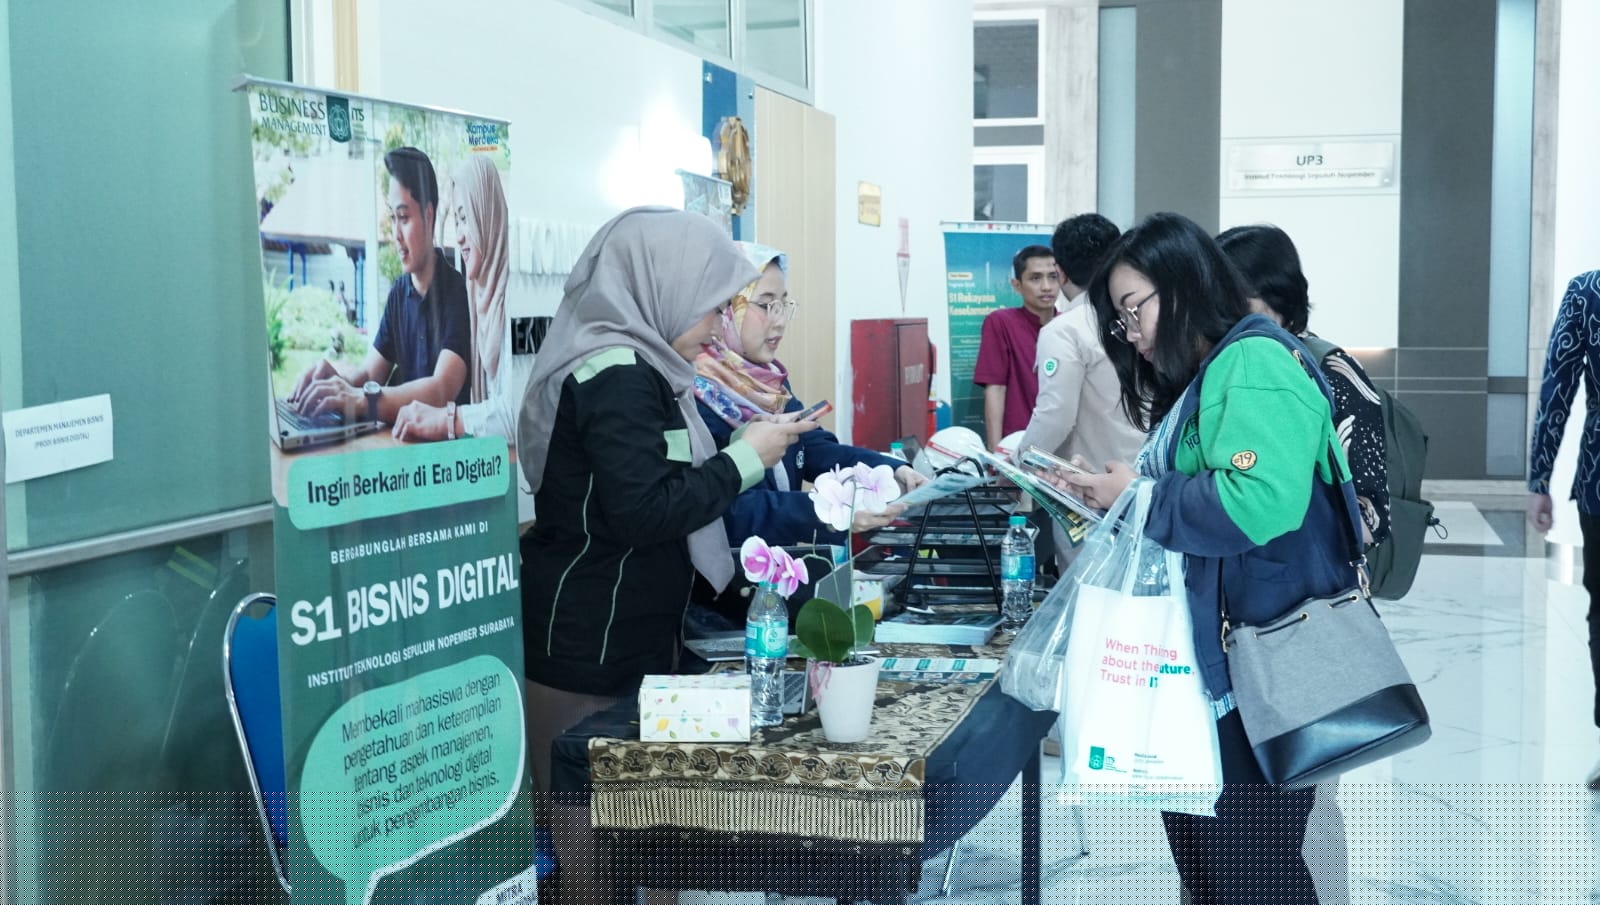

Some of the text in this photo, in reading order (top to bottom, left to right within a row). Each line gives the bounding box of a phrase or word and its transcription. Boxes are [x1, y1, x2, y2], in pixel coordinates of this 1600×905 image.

[259, 91, 326, 120] BUSINESS
[261, 117, 326, 137] MANAGEMENT
[1296, 155, 1324, 167] UP3
[307, 455, 502, 506] Ingin Berkarir di Era Digital?
[330, 520, 488, 565] BERGABUNGLAH BERSAMA KAMI DI
[290, 552, 519, 646] S1 BISNIS DIGITAL
[307, 615, 515, 688] INSTITUT TEKNOLOGI SEPULUH NOPEMBER SURABAYA
[1101, 654, 1137, 671] about
[1104, 638, 1139, 656] When
[1100, 669, 1131, 686] Trust
[1135, 676, 1146, 687] in
[341, 673, 501, 743] Membekali mahasiswa dengan
[344, 696, 502, 775] pengetahuan dan keterampilan
[354, 725, 494, 793] tentang aspek manajemen,
[394, 781, 415, 804] dan
[416, 758, 464, 792] teknologi
[466, 745, 492, 774] digital
[469, 771, 500, 796] bisnis.
